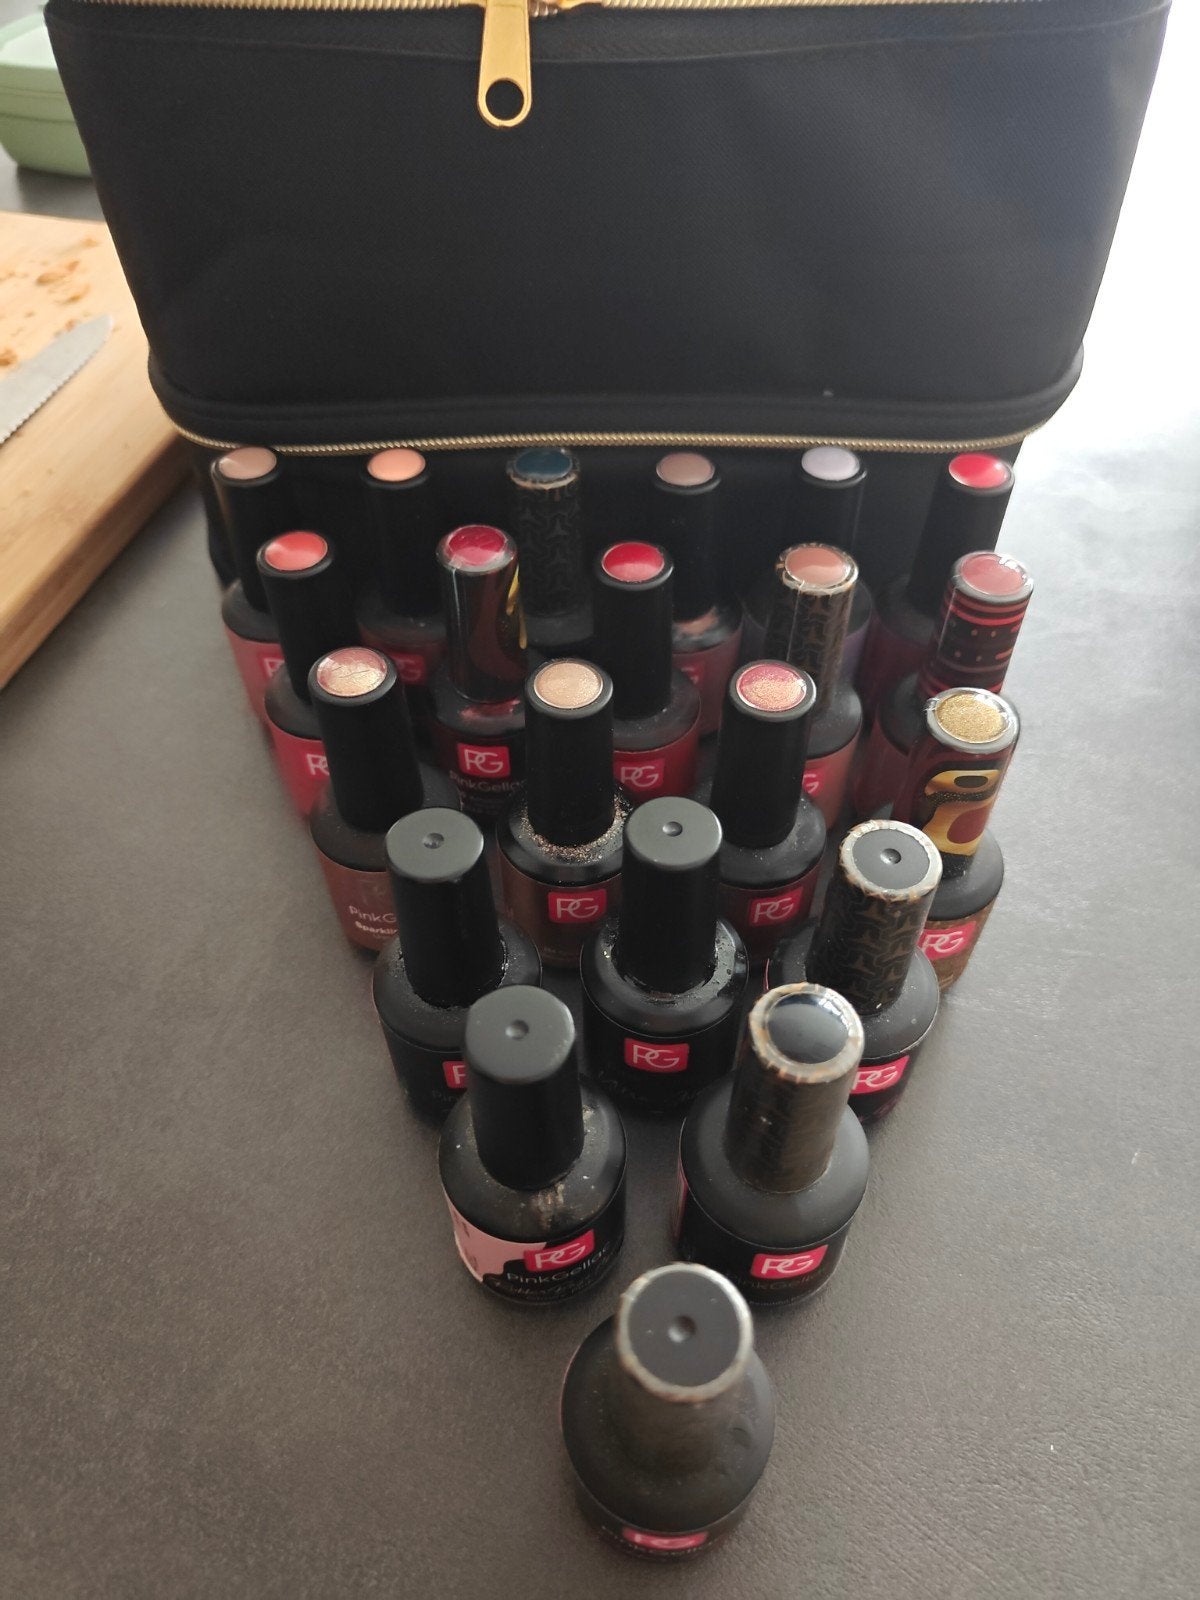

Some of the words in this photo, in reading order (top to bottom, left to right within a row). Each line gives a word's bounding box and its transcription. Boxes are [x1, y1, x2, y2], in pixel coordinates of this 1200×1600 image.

[263, 657, 285, 679] P
[464, 749, 505, 774] PG
[620, 765, 660, 788] PG
[348, 905, 397, 923] PinkG
[556, 897, 598, 919] PG
[753, 897, 794, 923] PG
[922, 930, 964, 954] PG
[632, 1044, 679, 1069] PG
[853, 1066, 898, 1091] PG
[534, 1242, 586, 1269] PG
[760, 1255, 814, 1275] PG
